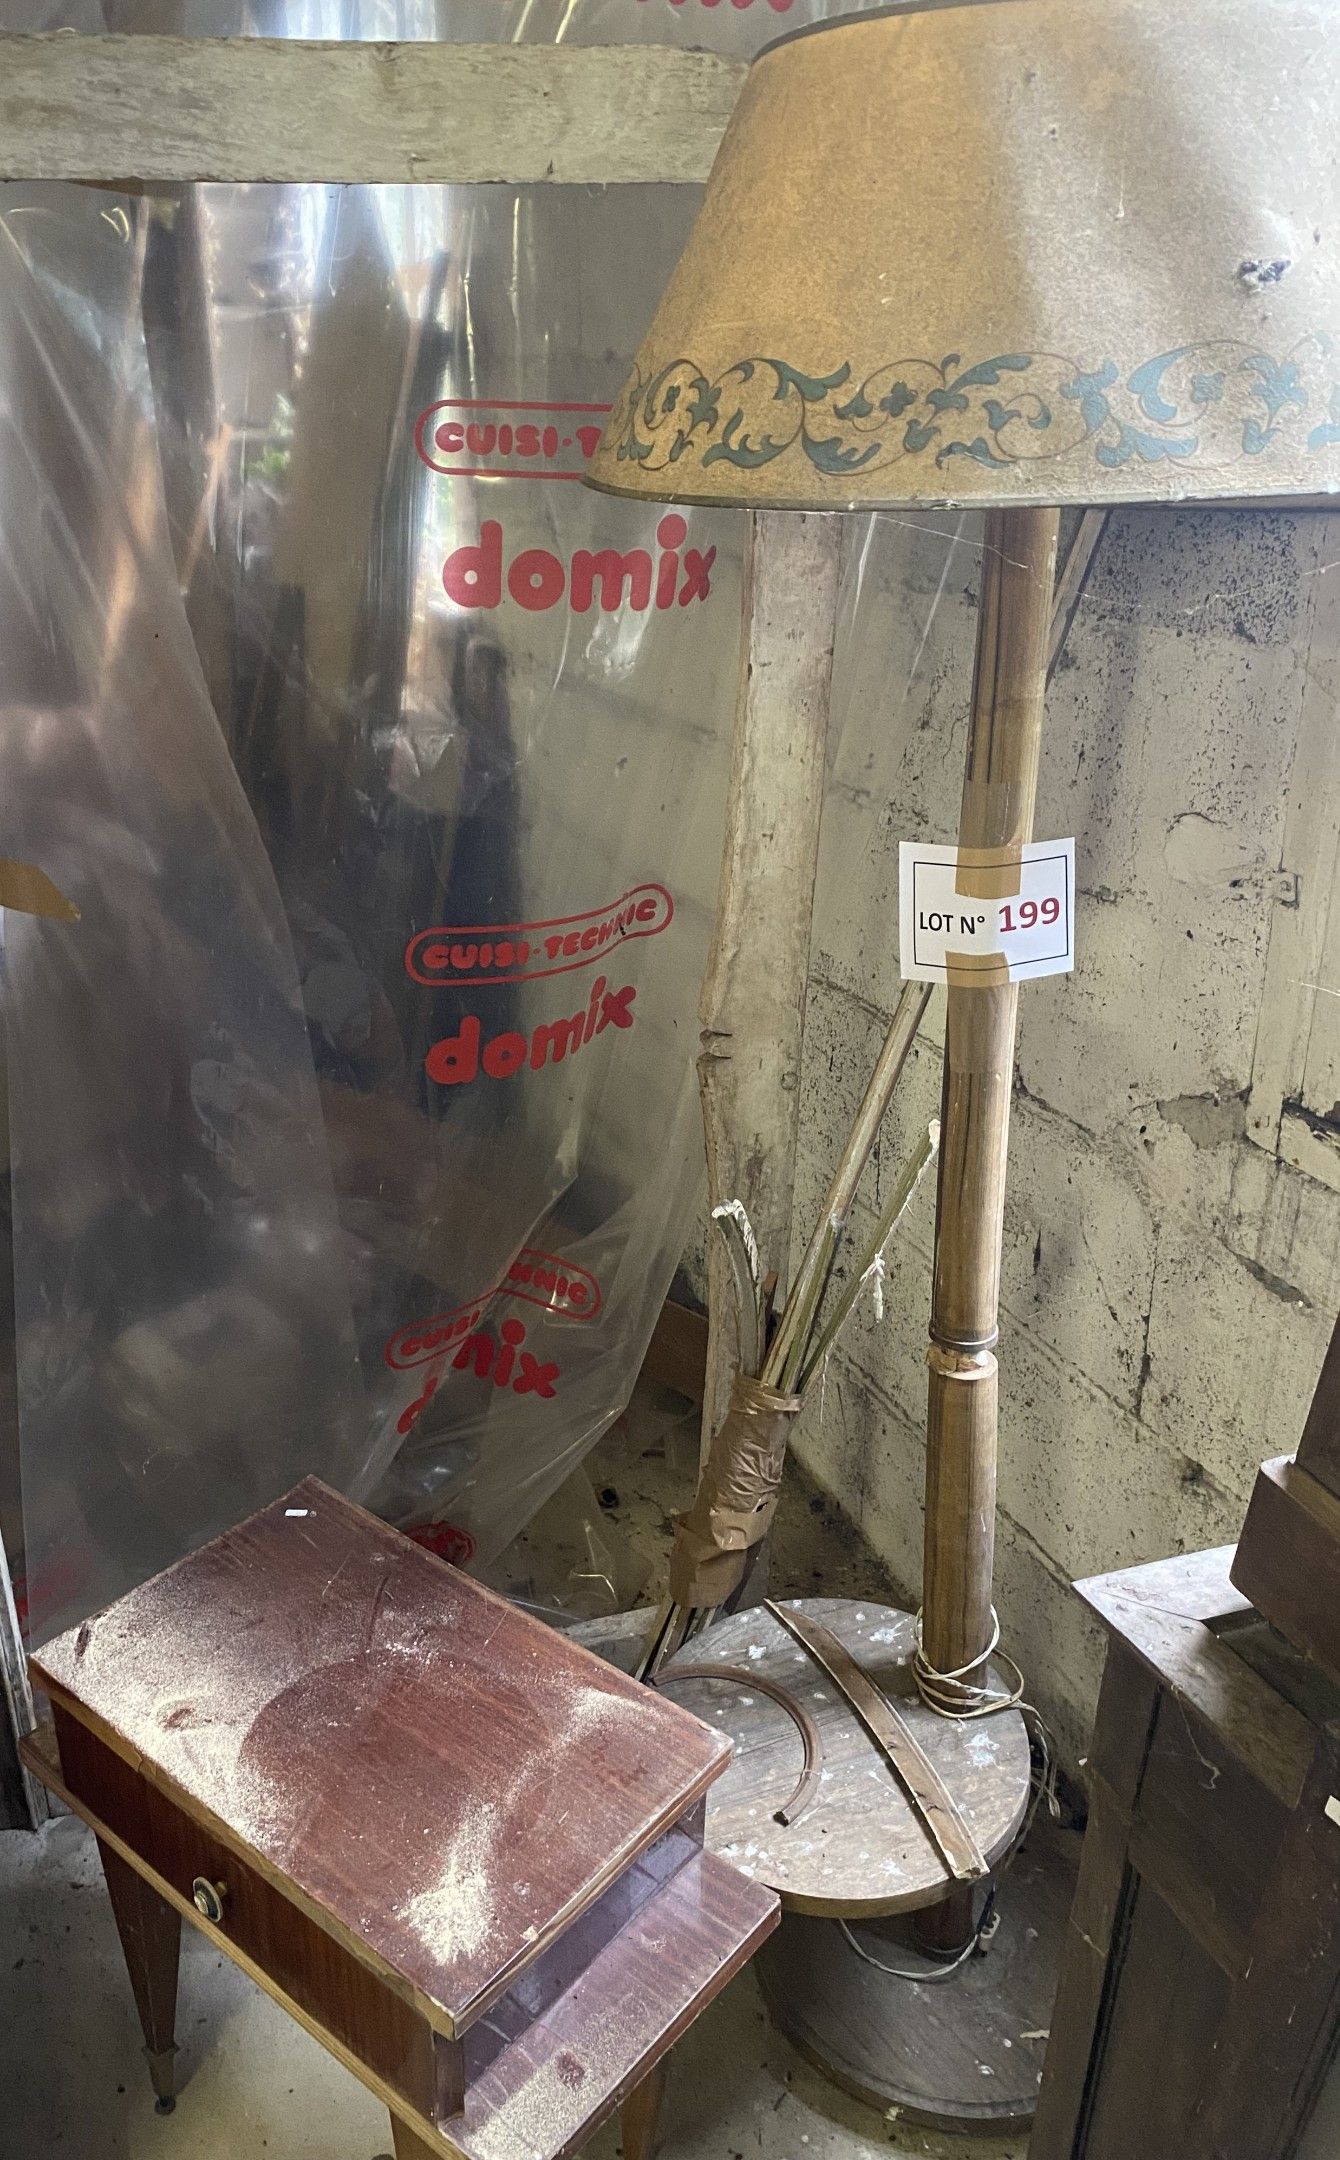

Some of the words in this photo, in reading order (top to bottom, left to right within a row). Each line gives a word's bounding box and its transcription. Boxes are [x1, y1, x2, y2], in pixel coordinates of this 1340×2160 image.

[442, 513, 716, 612] domix
[919, 912, 953, 932] LOT
[960, 915, 985, 935] N°
[998, 897, 1060, 933] 199
[426, 975, 636, 1084] domix
